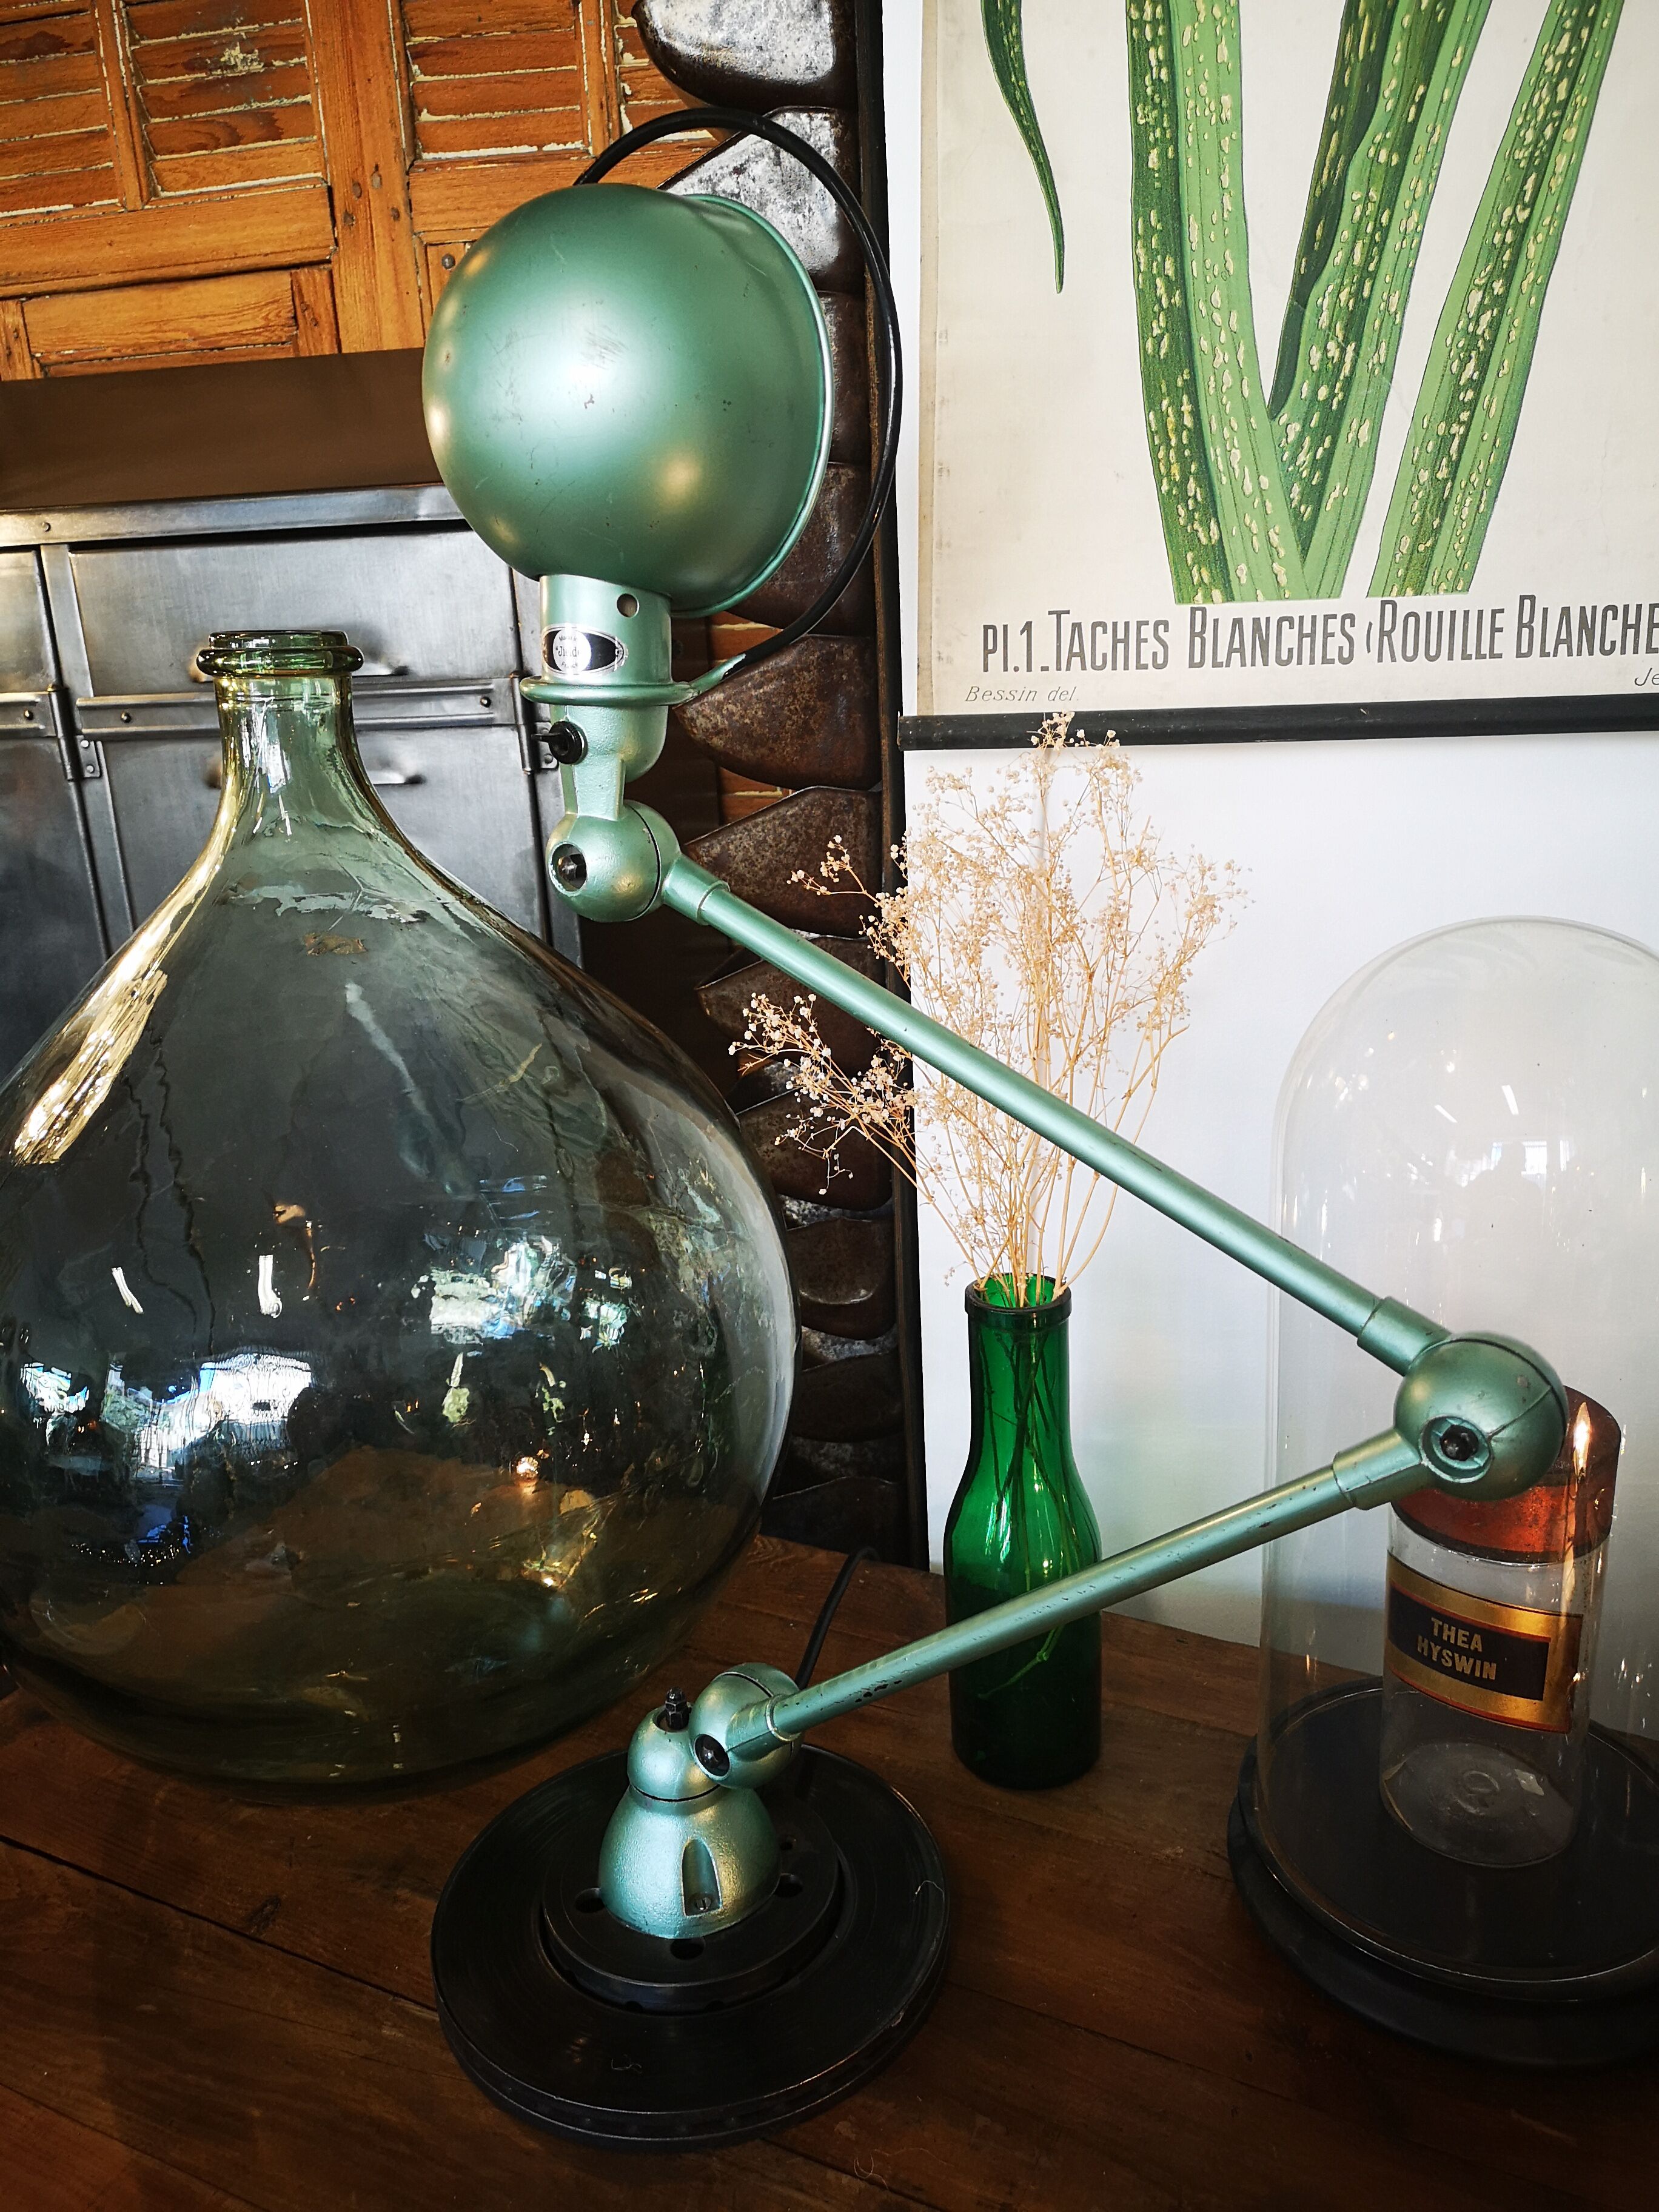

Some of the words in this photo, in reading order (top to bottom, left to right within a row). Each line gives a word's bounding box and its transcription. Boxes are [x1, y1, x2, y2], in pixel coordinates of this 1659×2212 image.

[1188, 606, 1356, 669] BLANCHES
[965, 686, 1038, 702] Bessin
[1431, 1617, 1483, 1652] THEA
[1416, 1635, 1497, 1681] HYSWIN
